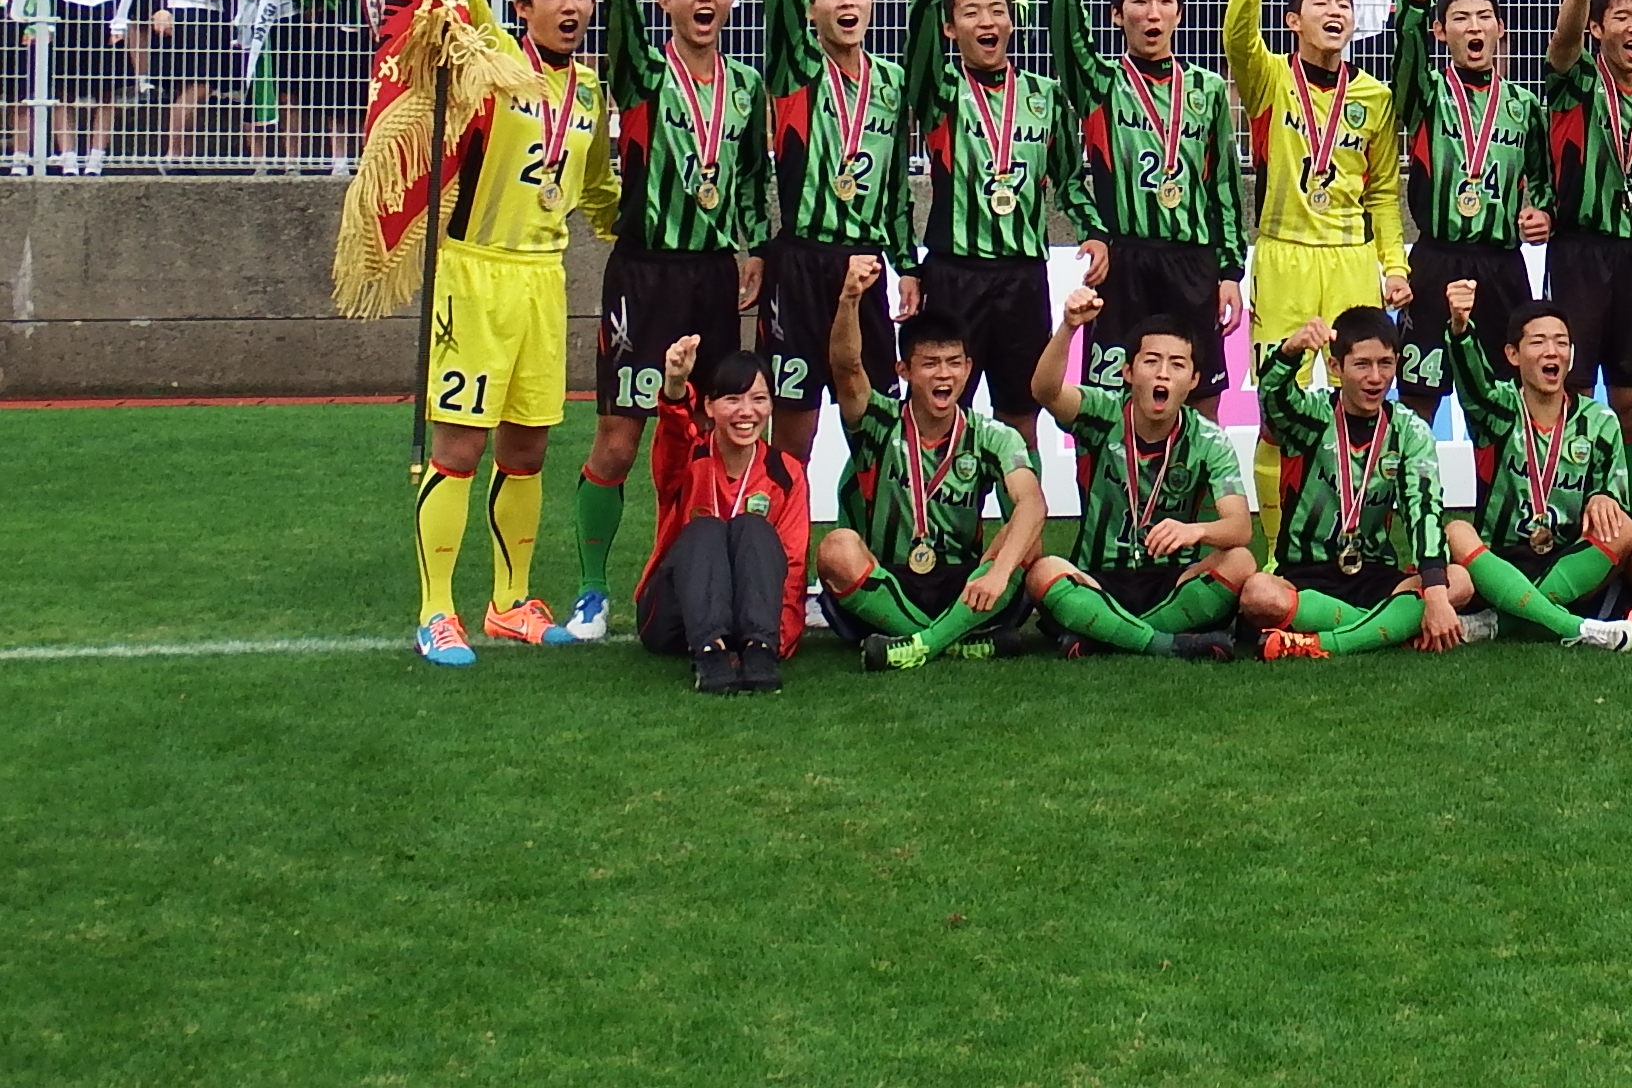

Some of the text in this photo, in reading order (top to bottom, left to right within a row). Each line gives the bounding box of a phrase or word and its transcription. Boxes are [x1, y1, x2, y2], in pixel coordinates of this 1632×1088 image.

[616, 366, 663, 409] 19
[771, 354, 809, 400] 12
[1401, 344, 1444, 387] 24
[438, 369, 489, 416] 21
